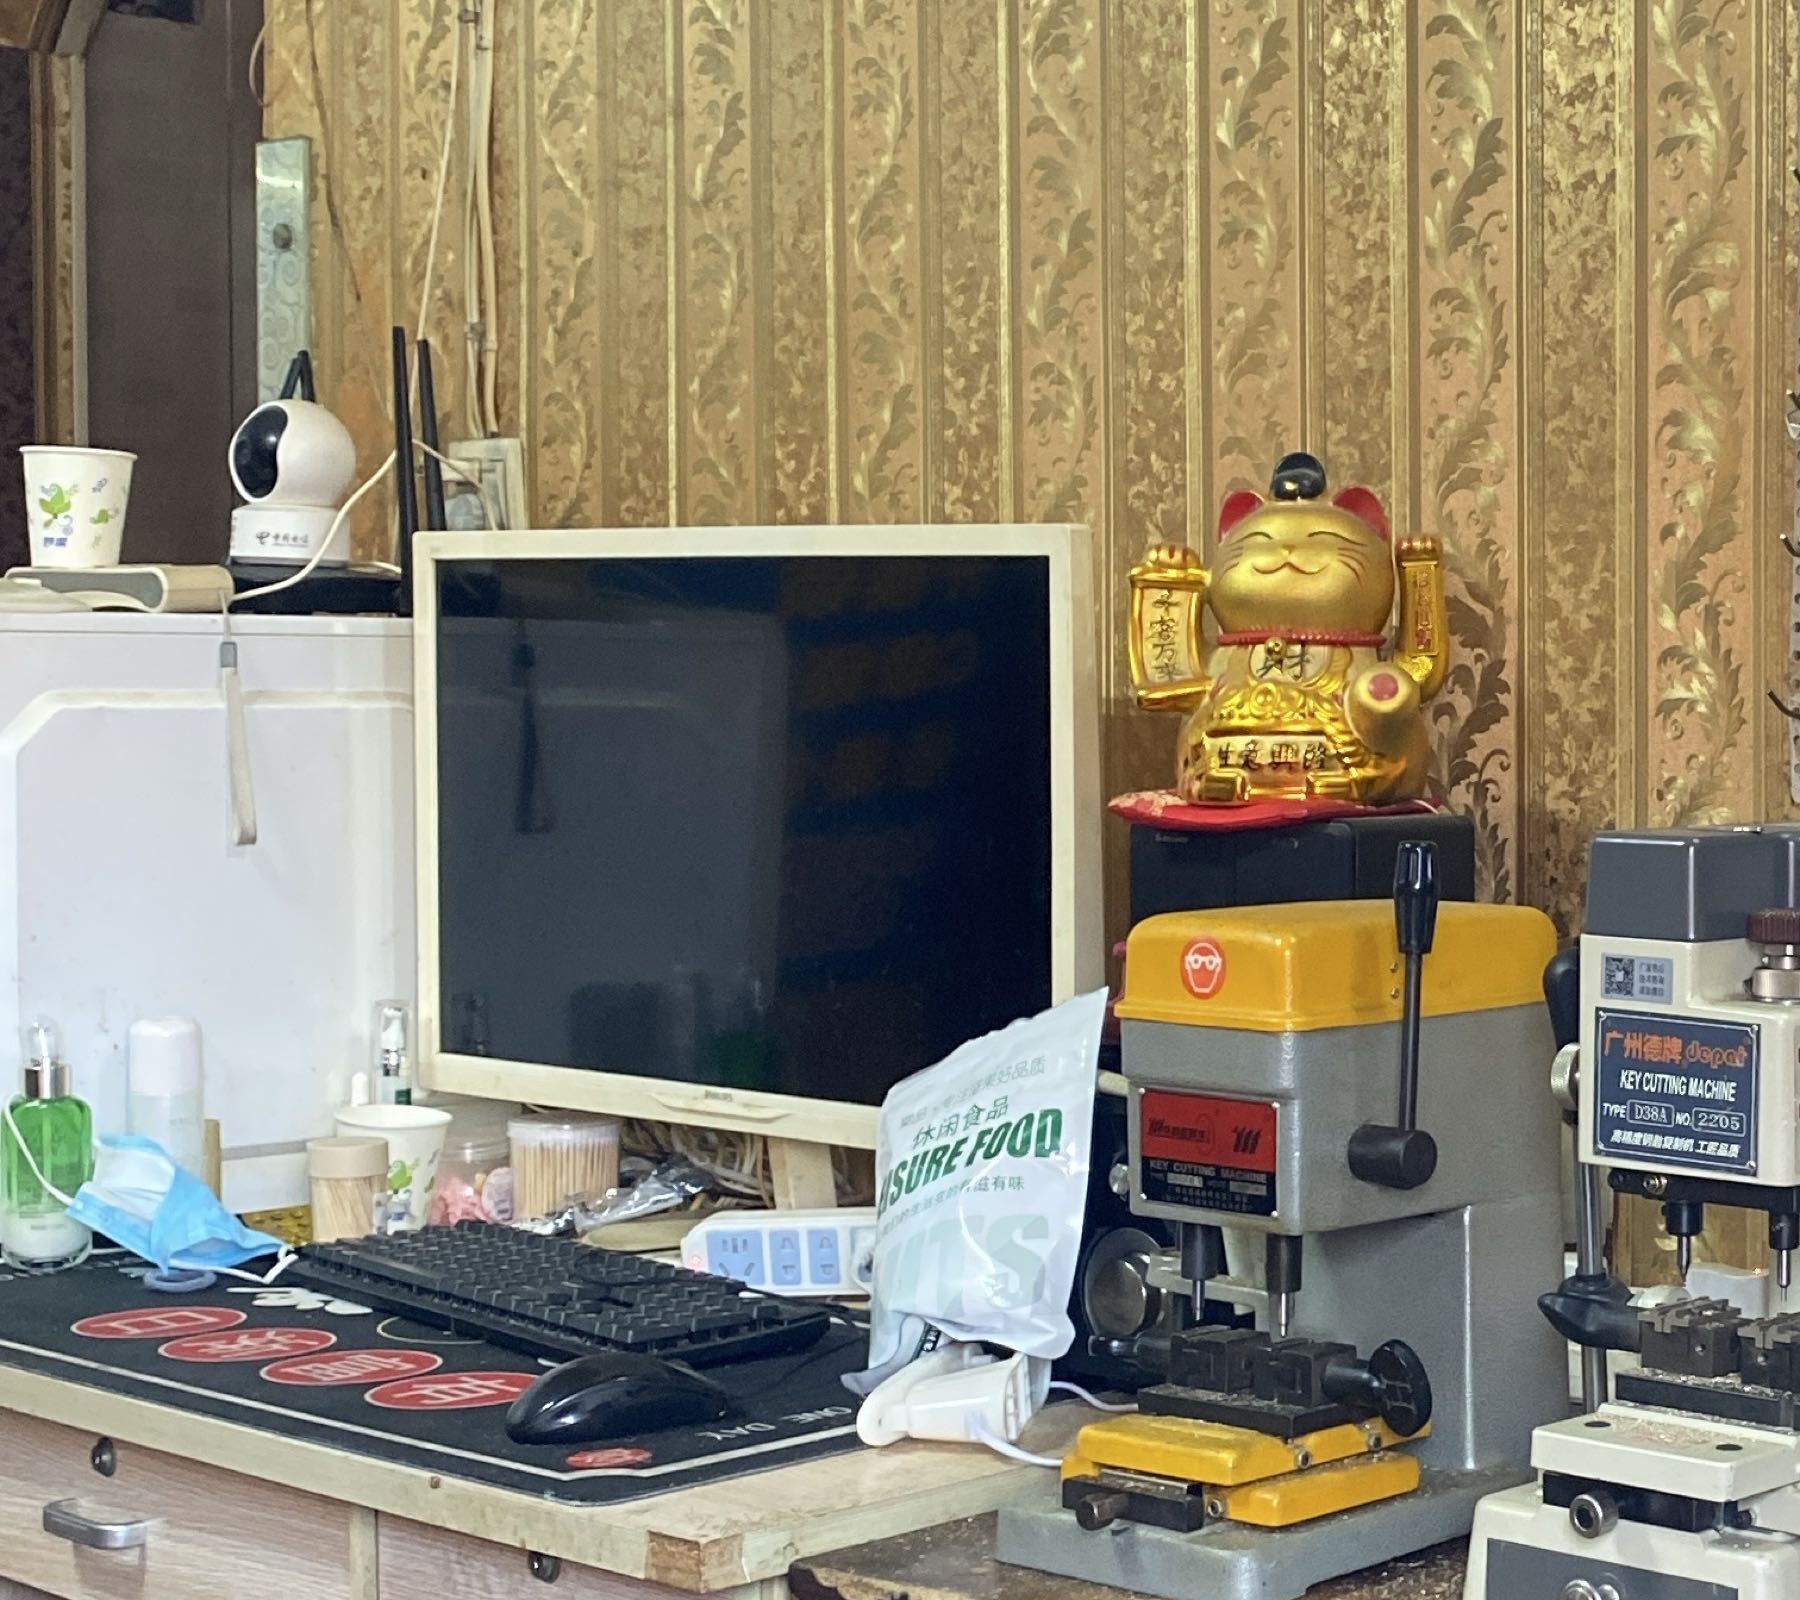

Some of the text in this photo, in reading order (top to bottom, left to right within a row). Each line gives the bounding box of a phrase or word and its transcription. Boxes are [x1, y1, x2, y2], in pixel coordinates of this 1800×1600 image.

[1604, 1029, 1683, 1065] 广州德牌
[1620, 1069, 1737, 1102] KEY CUTTING MACHINE
[913, 1095, 1009, 1149] 休闲食品
[1602, 1102, 1627, 1119] TYPE
[1635, 1106, 1668, 1124] D38A
[1698, 1111, 1741, 1131] 2205
[965, 1108, 1063, 1167] FOOD
[1149, 1160, 1168, 1171] KEY
[1173, 1162, 1216, 1177] CUTTING
[695, 1406, 853, 1441] ONE DAY
